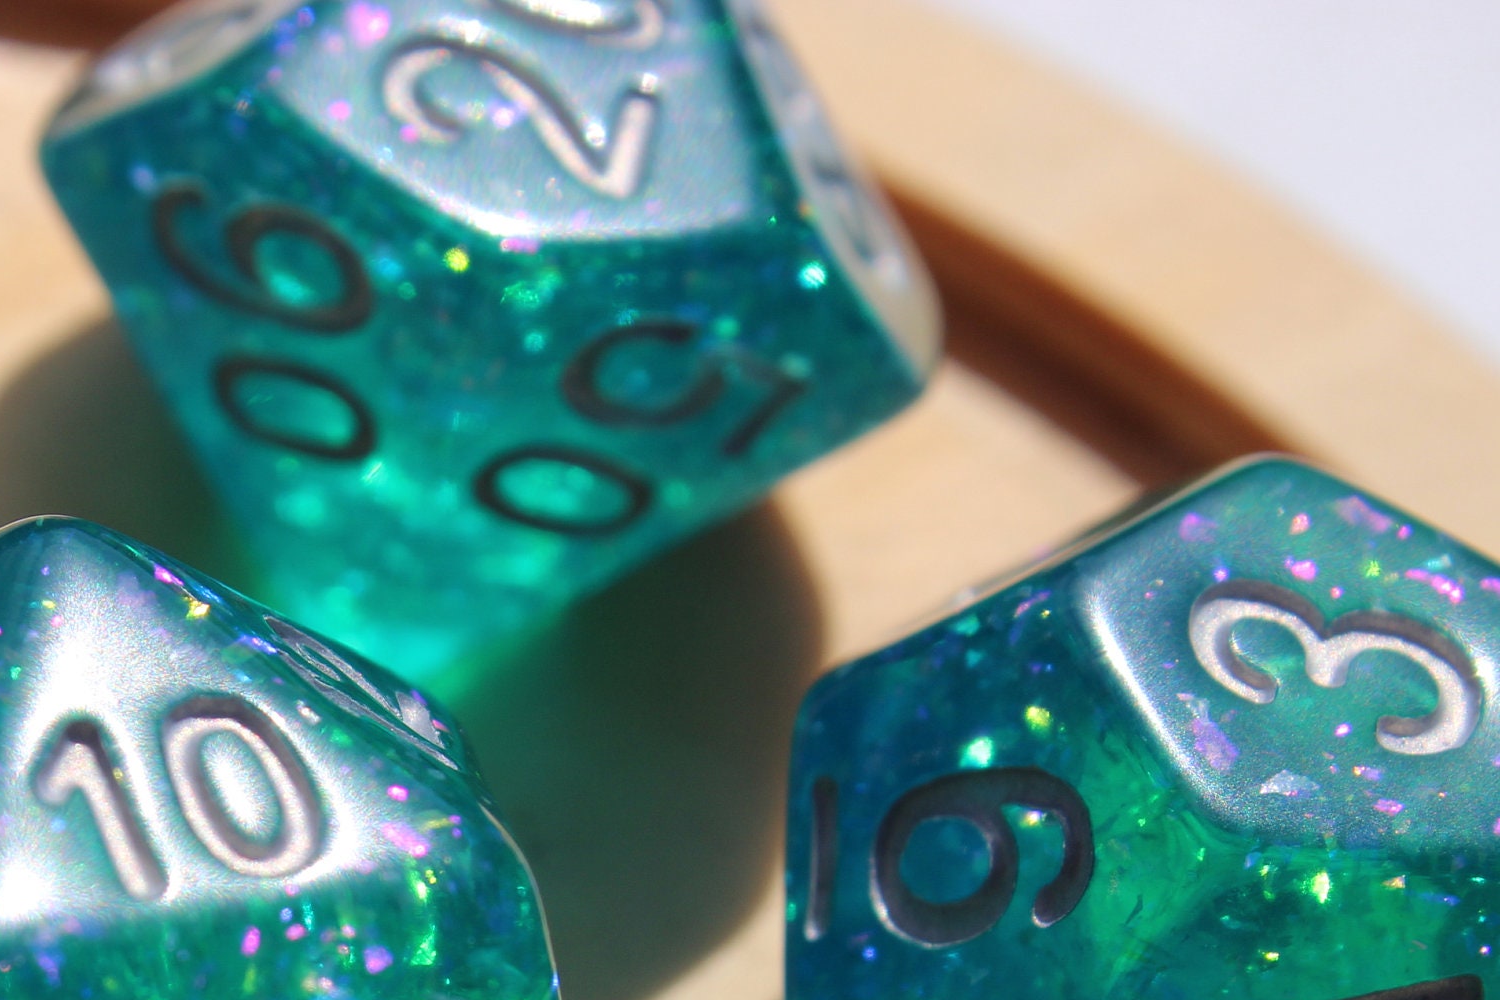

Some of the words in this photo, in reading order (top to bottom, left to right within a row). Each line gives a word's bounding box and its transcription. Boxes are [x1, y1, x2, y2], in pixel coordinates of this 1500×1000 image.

[473, 319, 811, 539] 50
[1189, 578, 1482, 755] 3
[34, 691, 326, 901] 10
